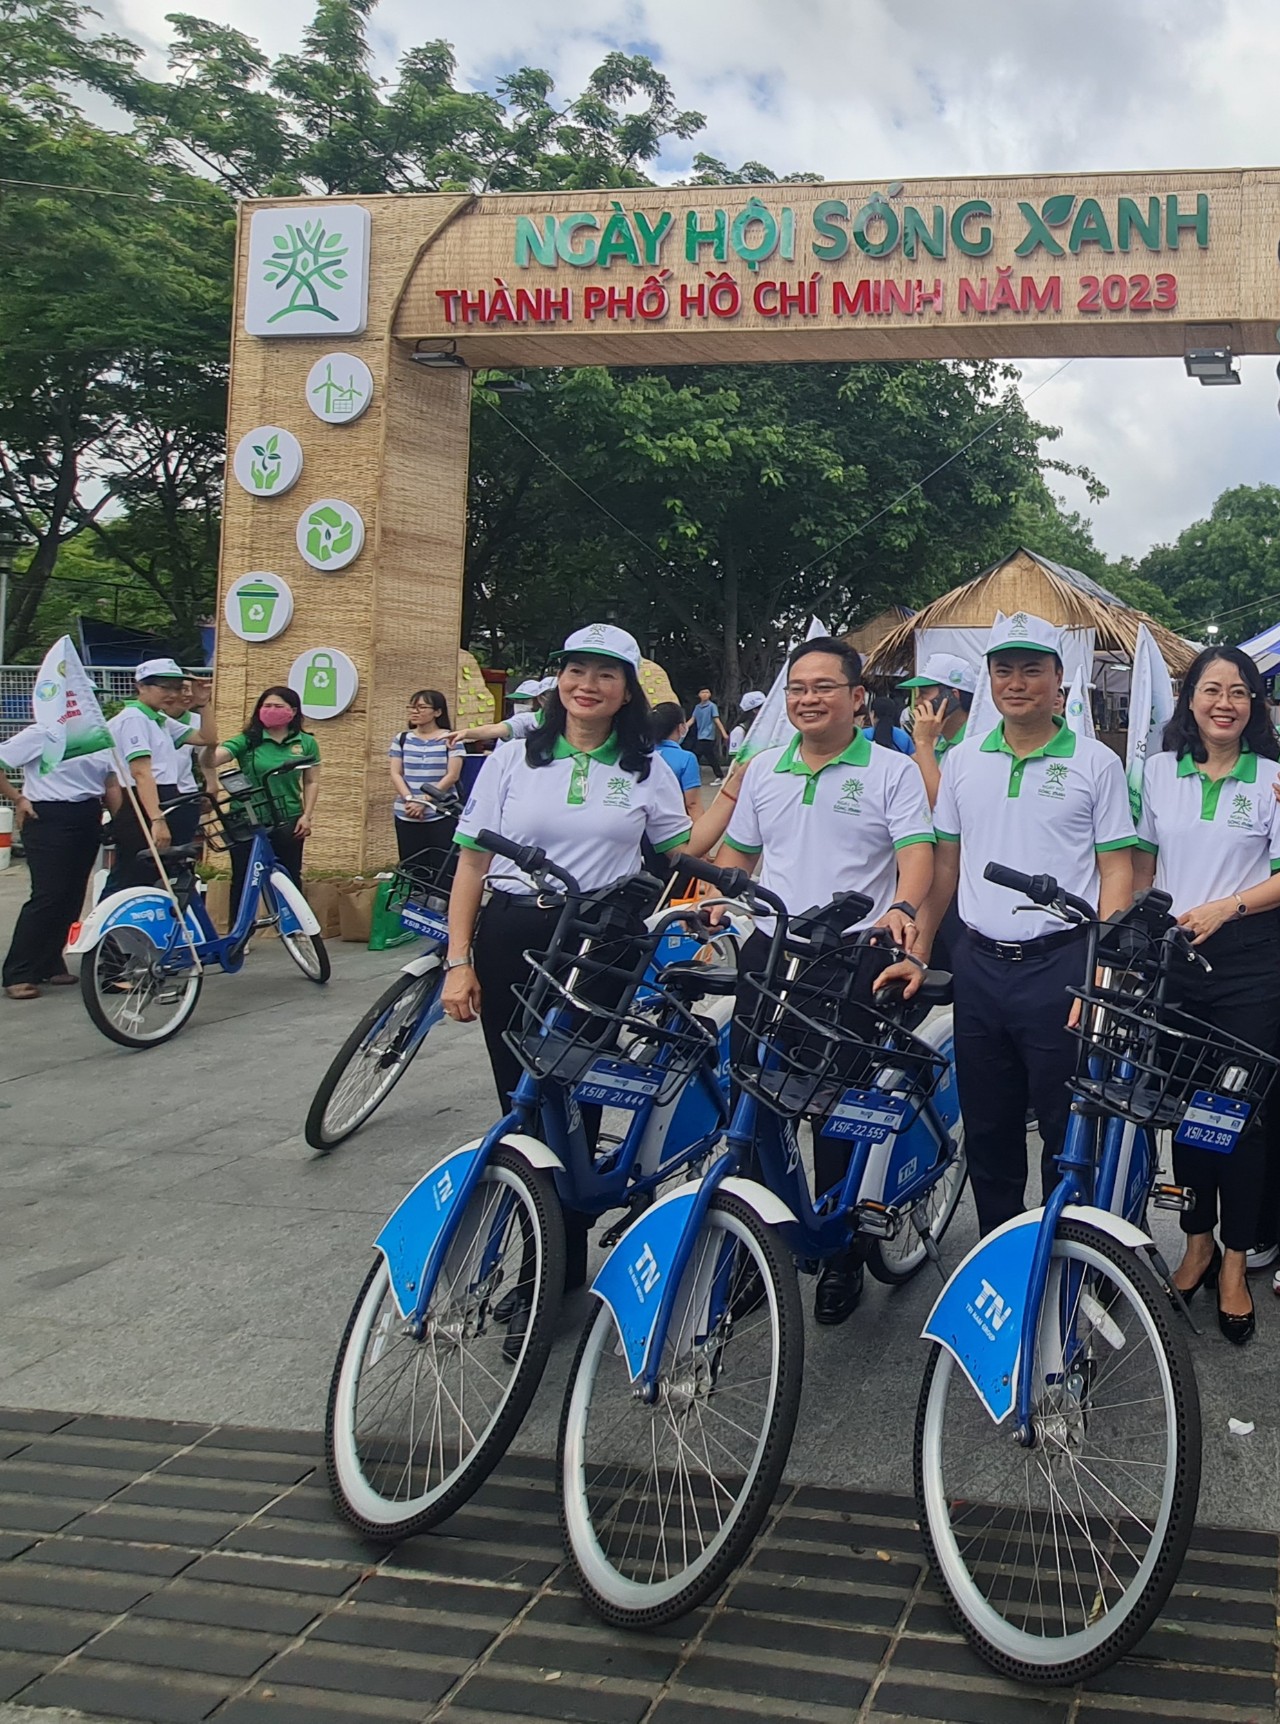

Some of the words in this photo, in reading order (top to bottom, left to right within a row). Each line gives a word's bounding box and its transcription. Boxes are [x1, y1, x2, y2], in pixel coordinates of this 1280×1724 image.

[514, 200, 675, 268] NGÀY
[684, 196, 795, 272] HỘI
[812, 182, 993, 261] SỐNG
[1013, 192, 1209, 257] XANH
[435, 277, 572, 323] THÀNH
[583, 268, 674, 320] PHỐ
[680, 270, 742, 319] HỒ
[753, 271, 822, 317] CHÍ
[832, 278, 942, 317] MINH
[958, 265, 1061, 313] NĂM
[1076, 273, 1178, 311] 2023
[635, 1241, 661, 1294] TN
[974, 1278, 1013, 1332] TN
